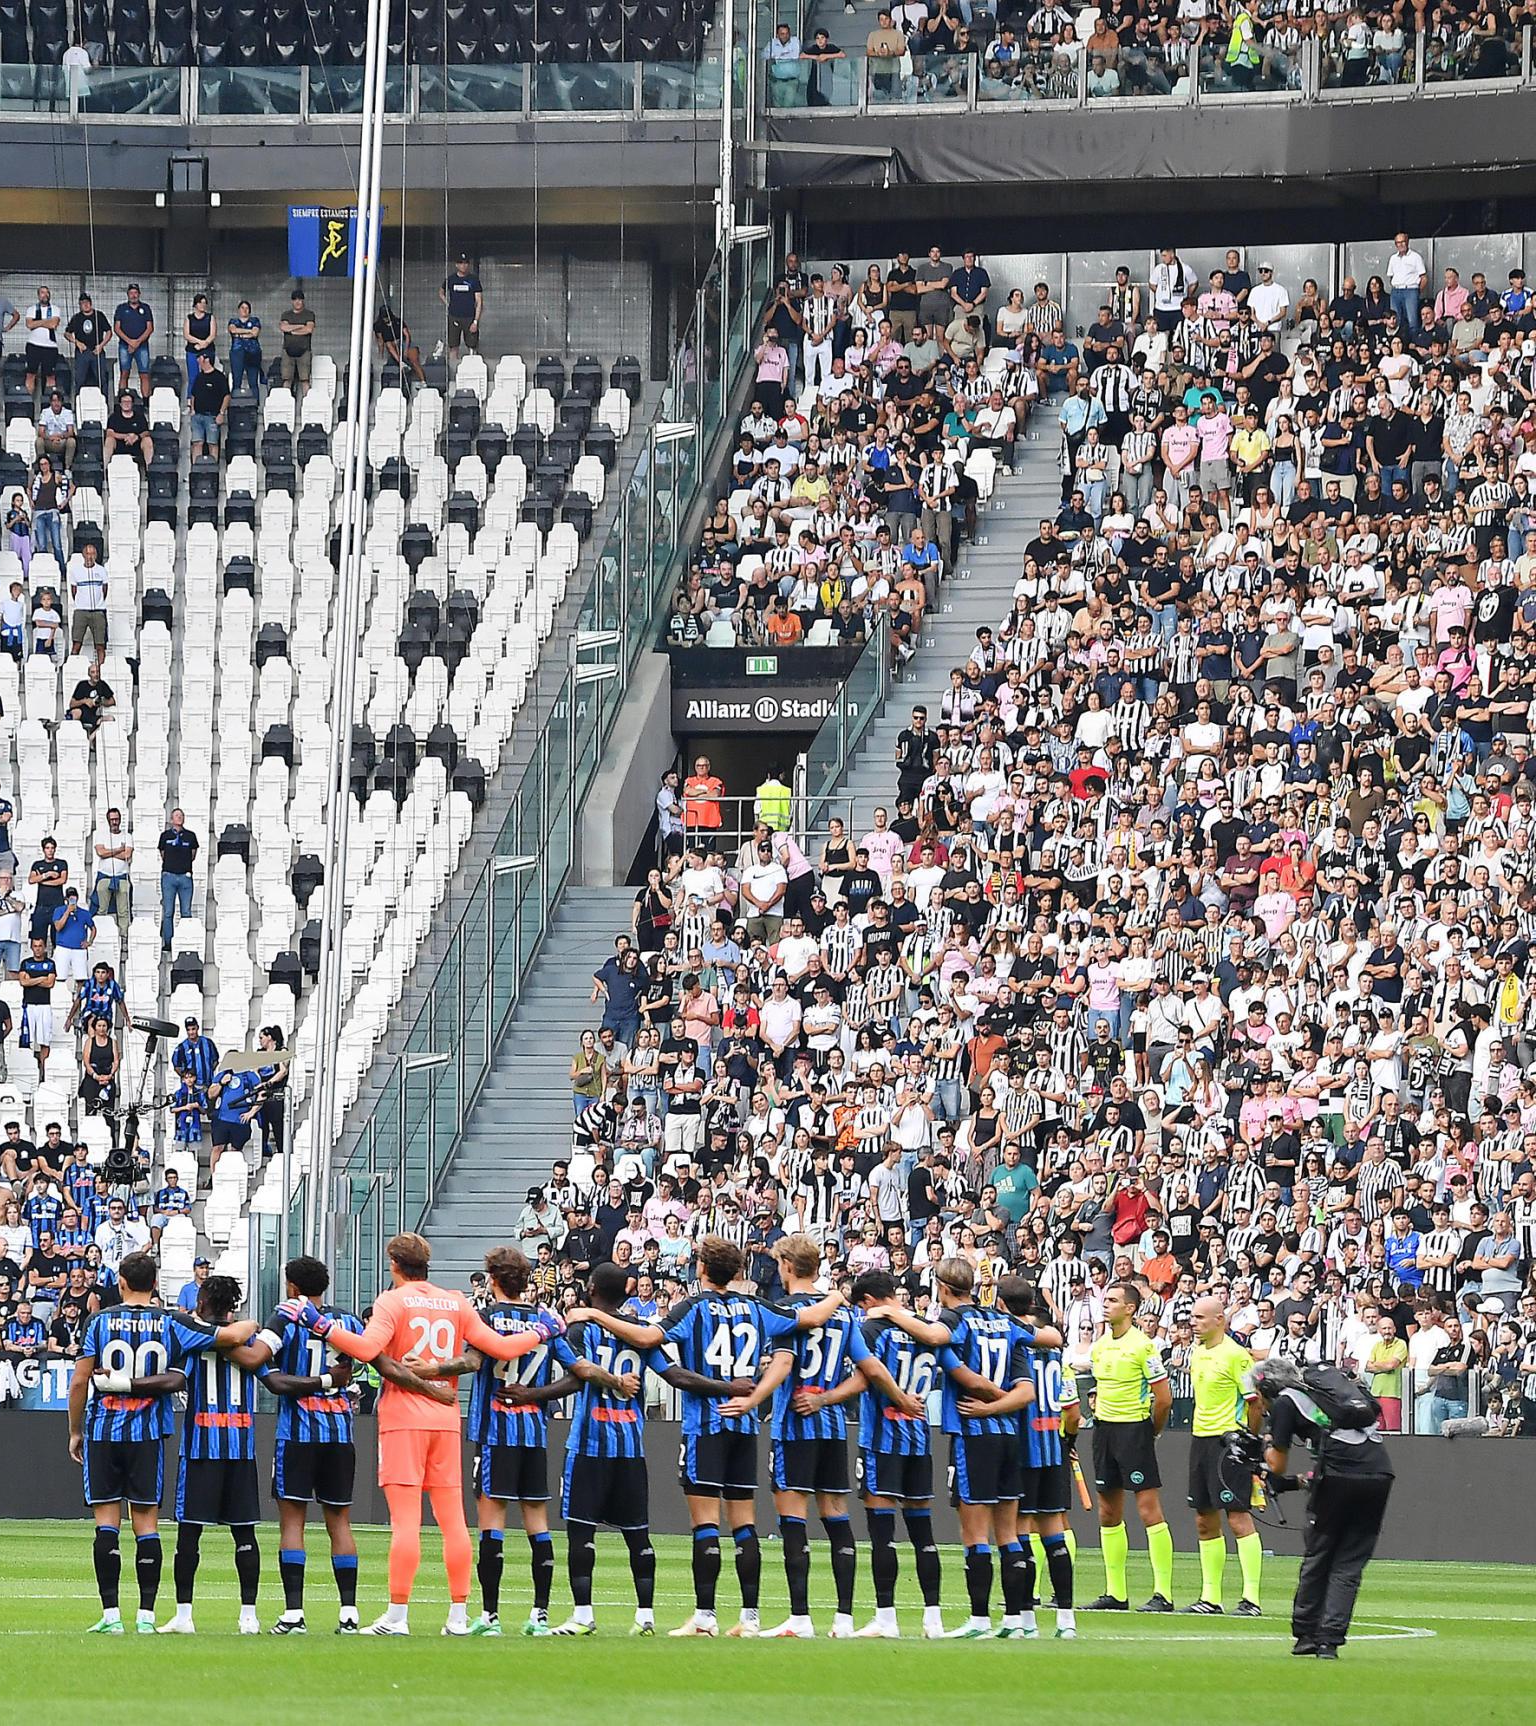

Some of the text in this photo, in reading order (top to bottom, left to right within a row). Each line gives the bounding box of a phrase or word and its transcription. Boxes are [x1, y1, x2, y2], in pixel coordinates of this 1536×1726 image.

[292, 209, 319, 218] SIEMPRE
[320, 209, 348, 218] ESTAMOS
[978, 537, 987, 545] 28
[962, 570, 971, 578] 27
[944, 605, 953, 613] 26
[926, 639, 935, 647] 25
[907, 673, 916, 682] 24
[686, 700, 751, 719] Allianz
[107, 1314, 164, 1333] KRSTOVIĆ
[409, 1317, 456, 1361] 29
[705, 1323, 758, 1377] 42
[102, 1340, 167, 1379] 90
[493, 1345, 548, 1387] 47
[977, 1336, 1008, 1390] 17
[201, 1352, 242, 1405] 11
[896, 1350, 936, 1400] 16
[1033, 1360, 1061, 1412] 10
